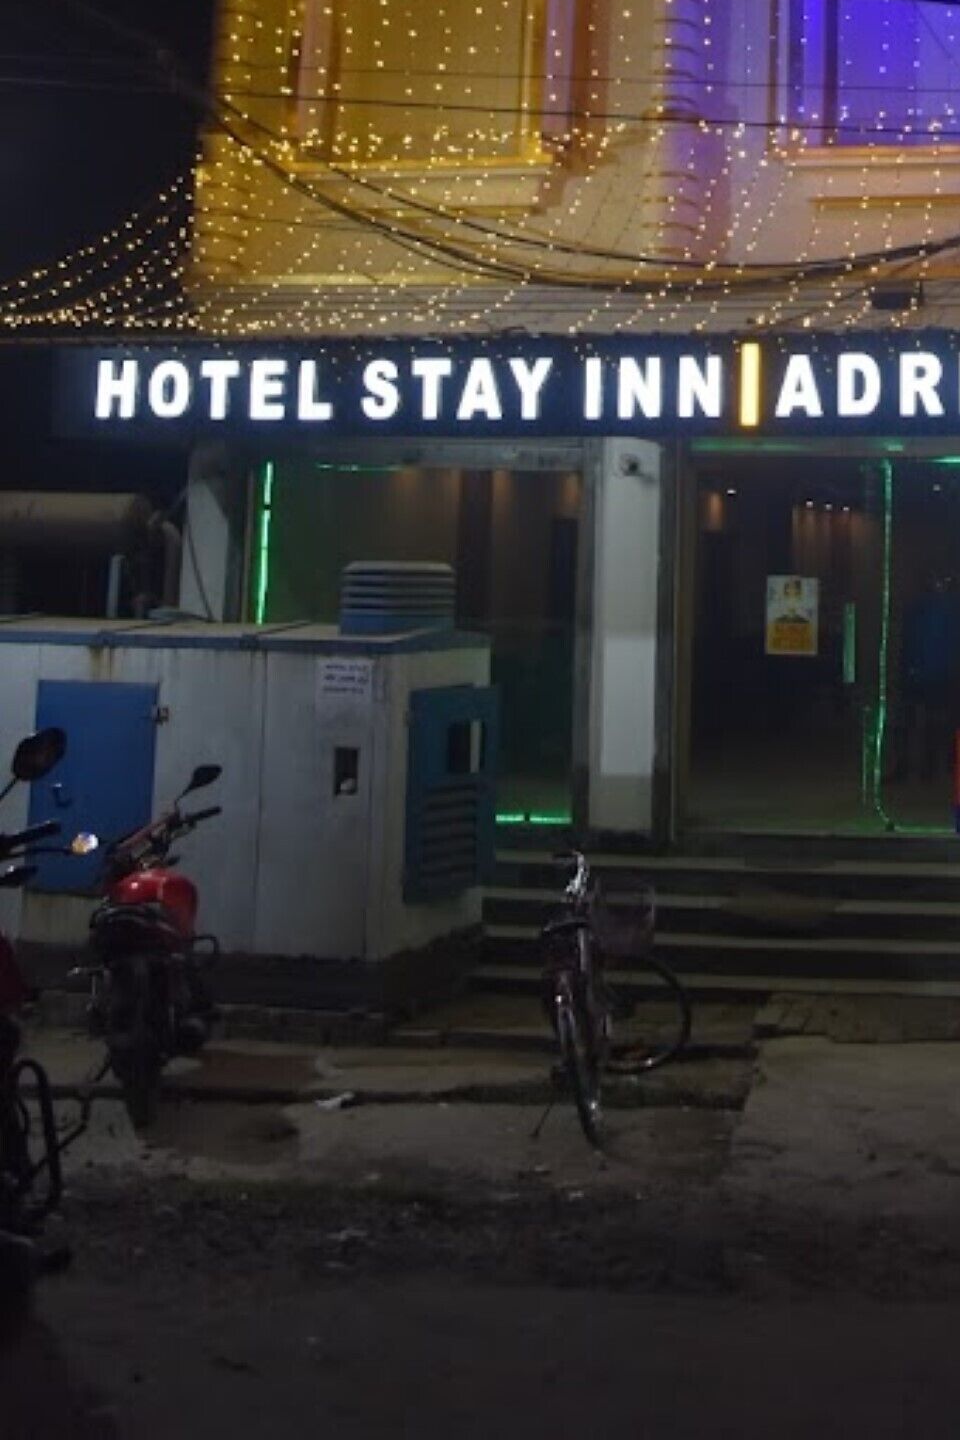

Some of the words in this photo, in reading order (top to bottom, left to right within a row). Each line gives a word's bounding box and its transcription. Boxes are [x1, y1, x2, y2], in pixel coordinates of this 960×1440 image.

[94, 358, 333, 421] HOTEL
[360, 356, 554, 421] STAY
[582, 353, 724, 421] INN
